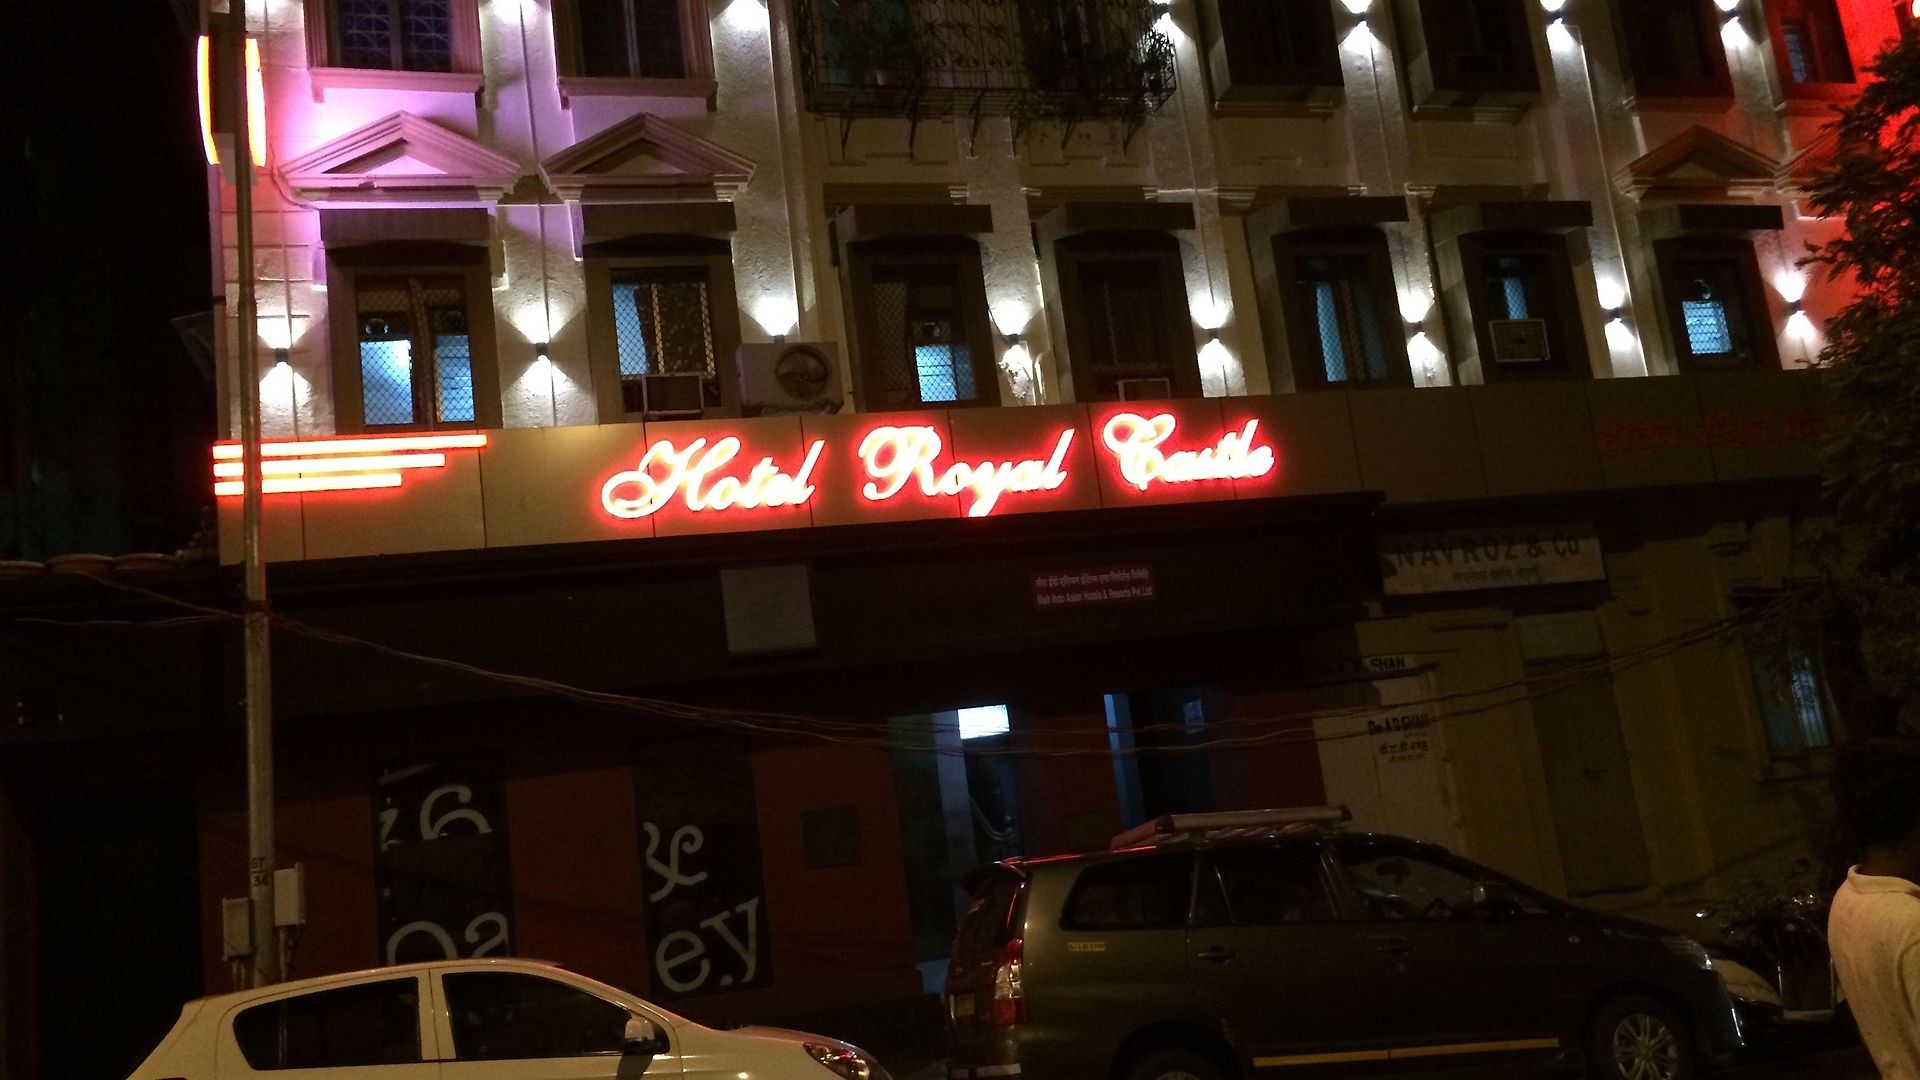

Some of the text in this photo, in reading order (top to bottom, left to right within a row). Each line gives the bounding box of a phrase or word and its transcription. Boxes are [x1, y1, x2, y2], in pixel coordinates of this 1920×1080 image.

[601, 412, 1275, 519] Hotel Royal Castle
[1395, 536, 1515, 568] NAVROZ
[1526, 534, 1545, 559] &
[1370, 656, 1405, 671] SHAH
